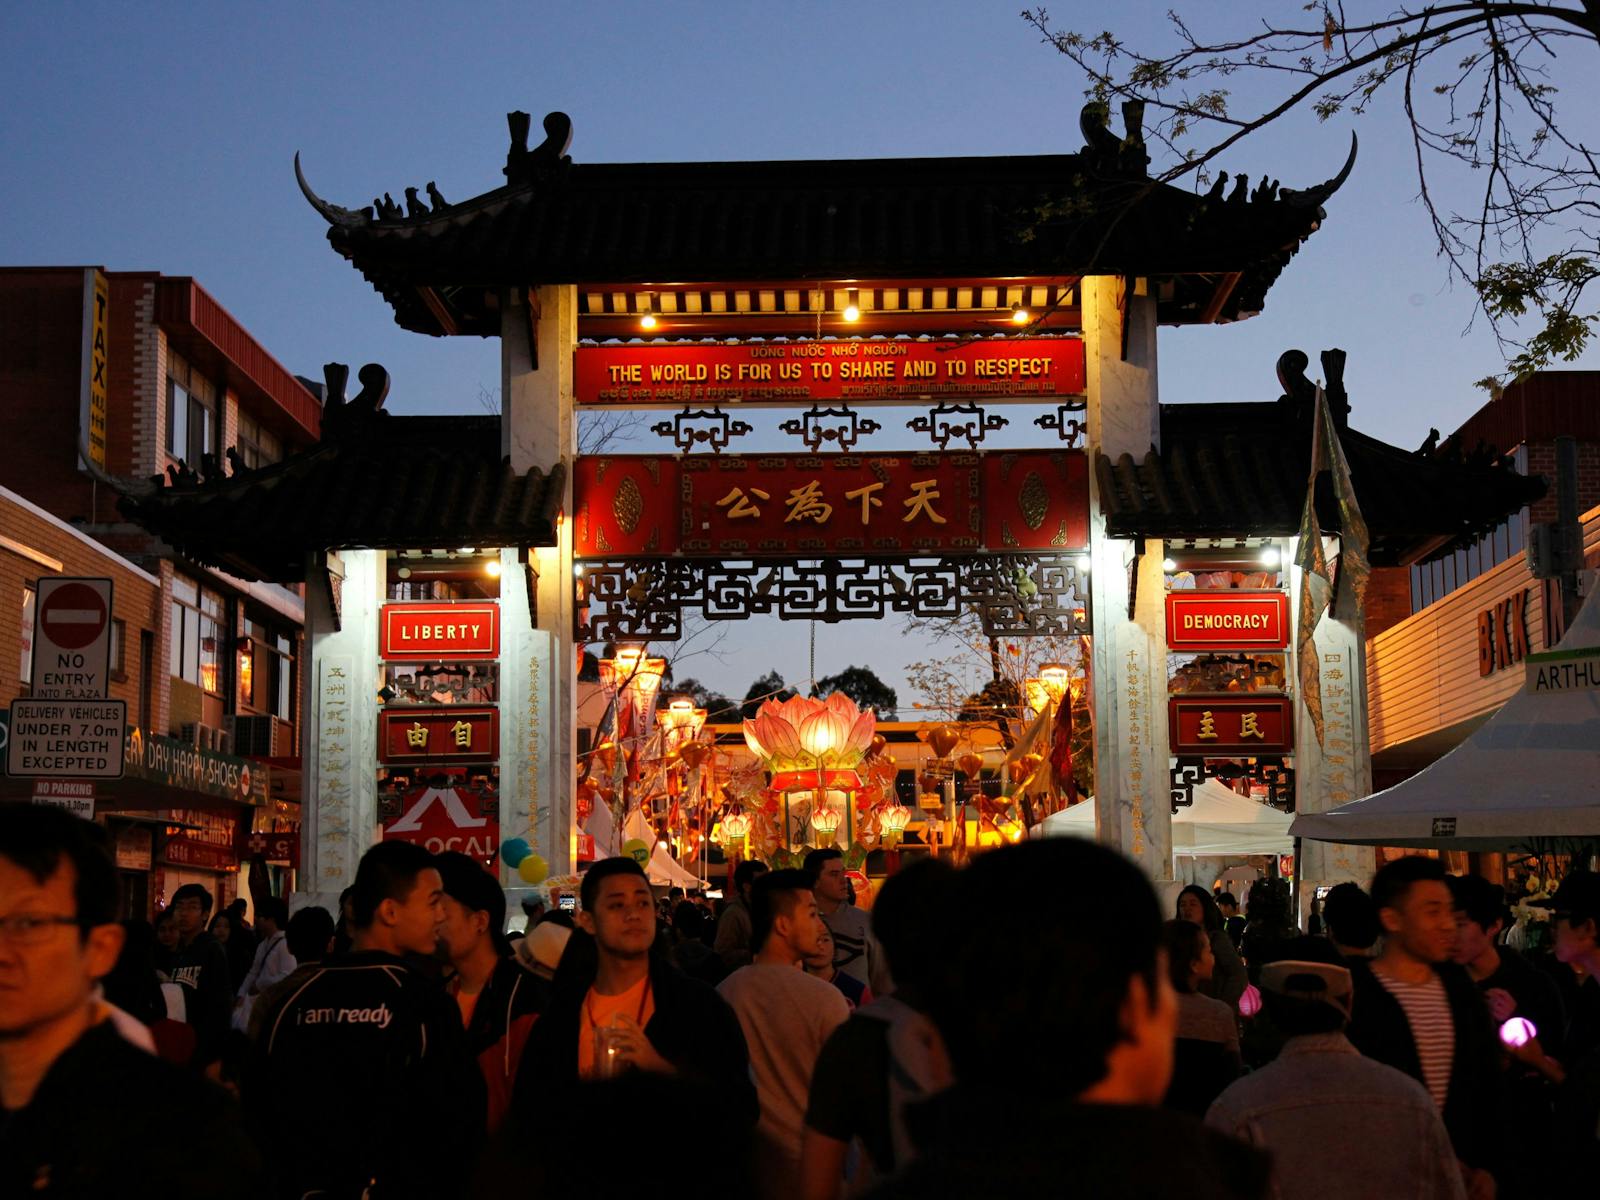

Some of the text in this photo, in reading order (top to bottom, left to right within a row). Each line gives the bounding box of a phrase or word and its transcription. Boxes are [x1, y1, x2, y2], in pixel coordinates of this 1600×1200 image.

[93, 292, 106, 390] TAX
[609, 358, 1052, 382] THE WORLD IS FOR US TO SHARE AND TO RESPECT
[1183, 613, 1270, 630] DEMOCRACY
[401, 624, 481, 640] LIBERTY
[1478, 588, 1529, 677] BKK
[58, 654, 84, 668] NO
[44, 673, 96, 685] ENTRY
[38, 689, 100, 698] INTO PLAZA
[17, 707, 119, 720] DELIVERY VEHICLES
[17, 723, 118, 737] UNDER 7.0m
[23, 740, 109, 753] IN LENGTH
[23, 756, 107, 769] EXCEPTED
[124, 735, 145, 765] ERY
[148, 741, 170, 773] DAY
[173, 748, 206, 781] HAPPY
[208, 758, 238, 789] SHOES
[37, 782, 93, 795] NO PARKING
[296, 1002, 393, 1029] i am ready
